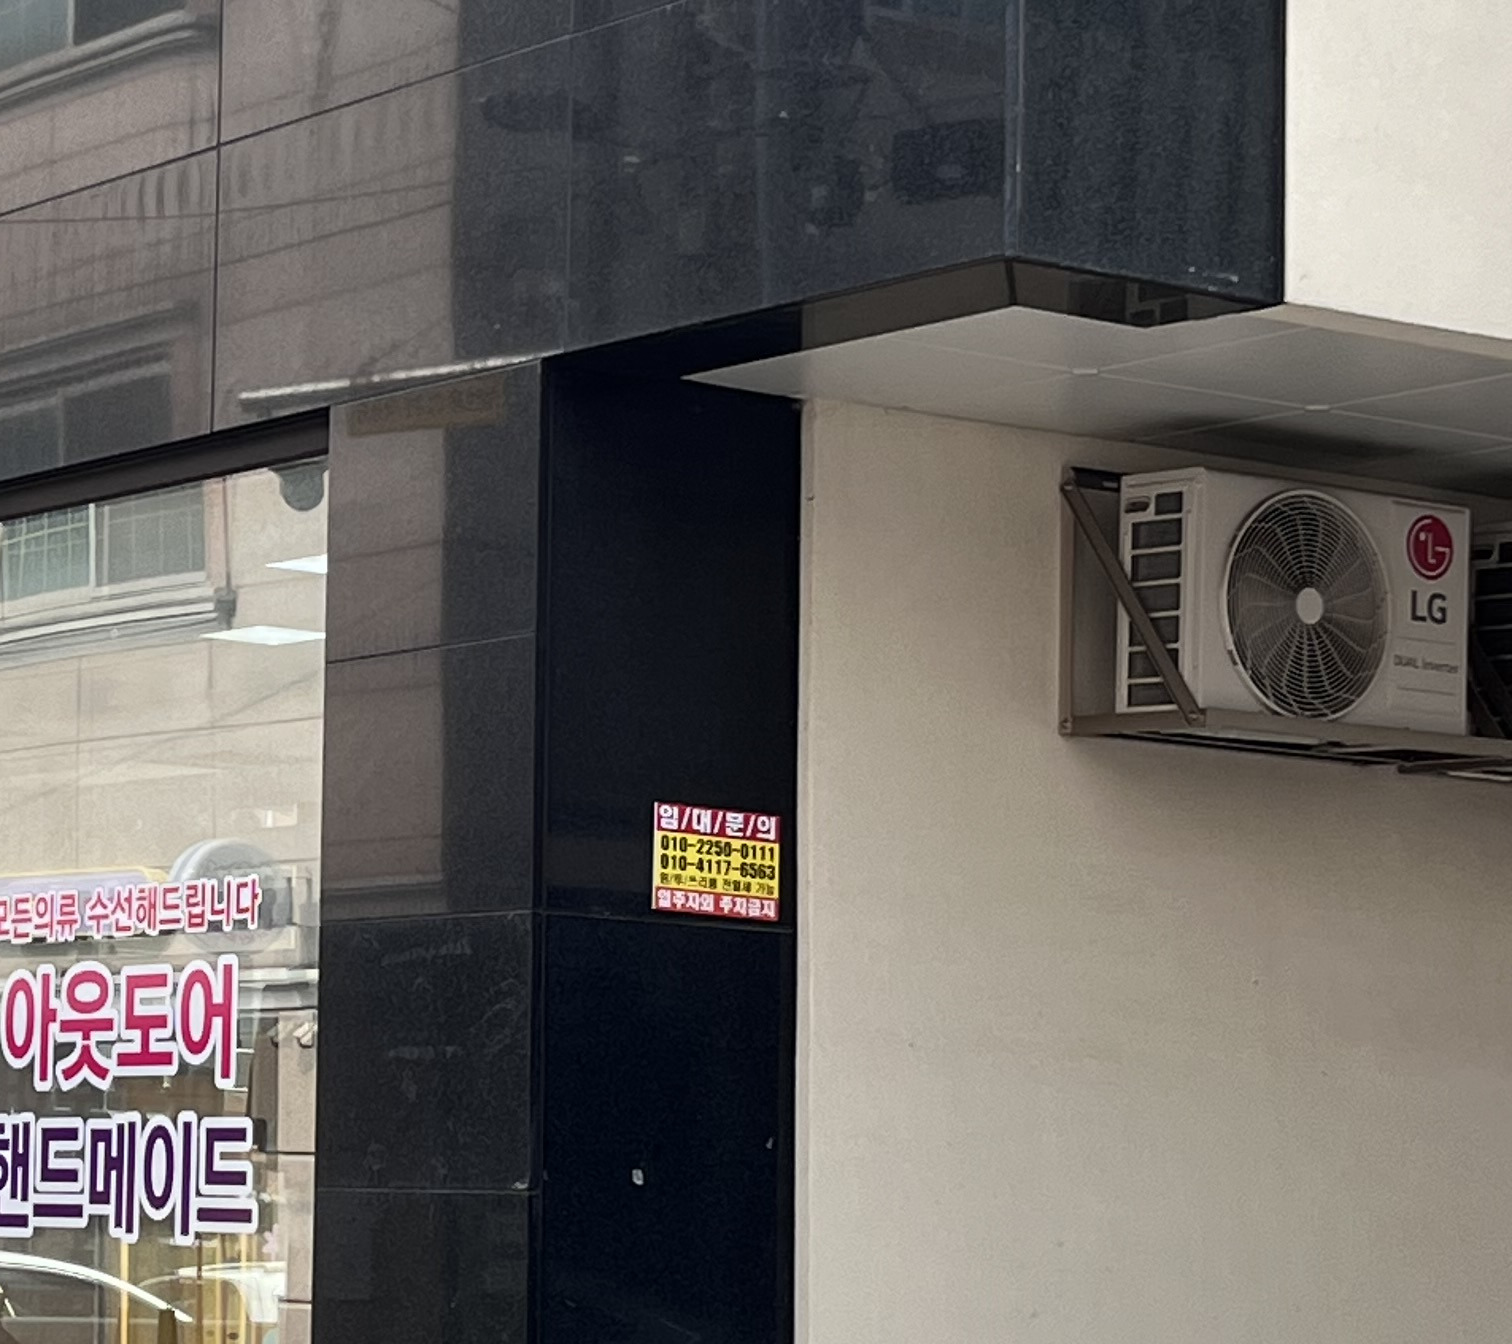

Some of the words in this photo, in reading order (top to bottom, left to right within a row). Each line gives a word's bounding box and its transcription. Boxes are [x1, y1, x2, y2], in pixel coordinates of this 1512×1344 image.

[1410, 590, 1448, 624] LG
[661, 835, 775, 862] 010-2250-0111
[660, 853, 776, 880] 010-4117-6563
[86, 875, 262, 939] 수선해드립니다
[2, 958, 236, 1088] 아웃도어
